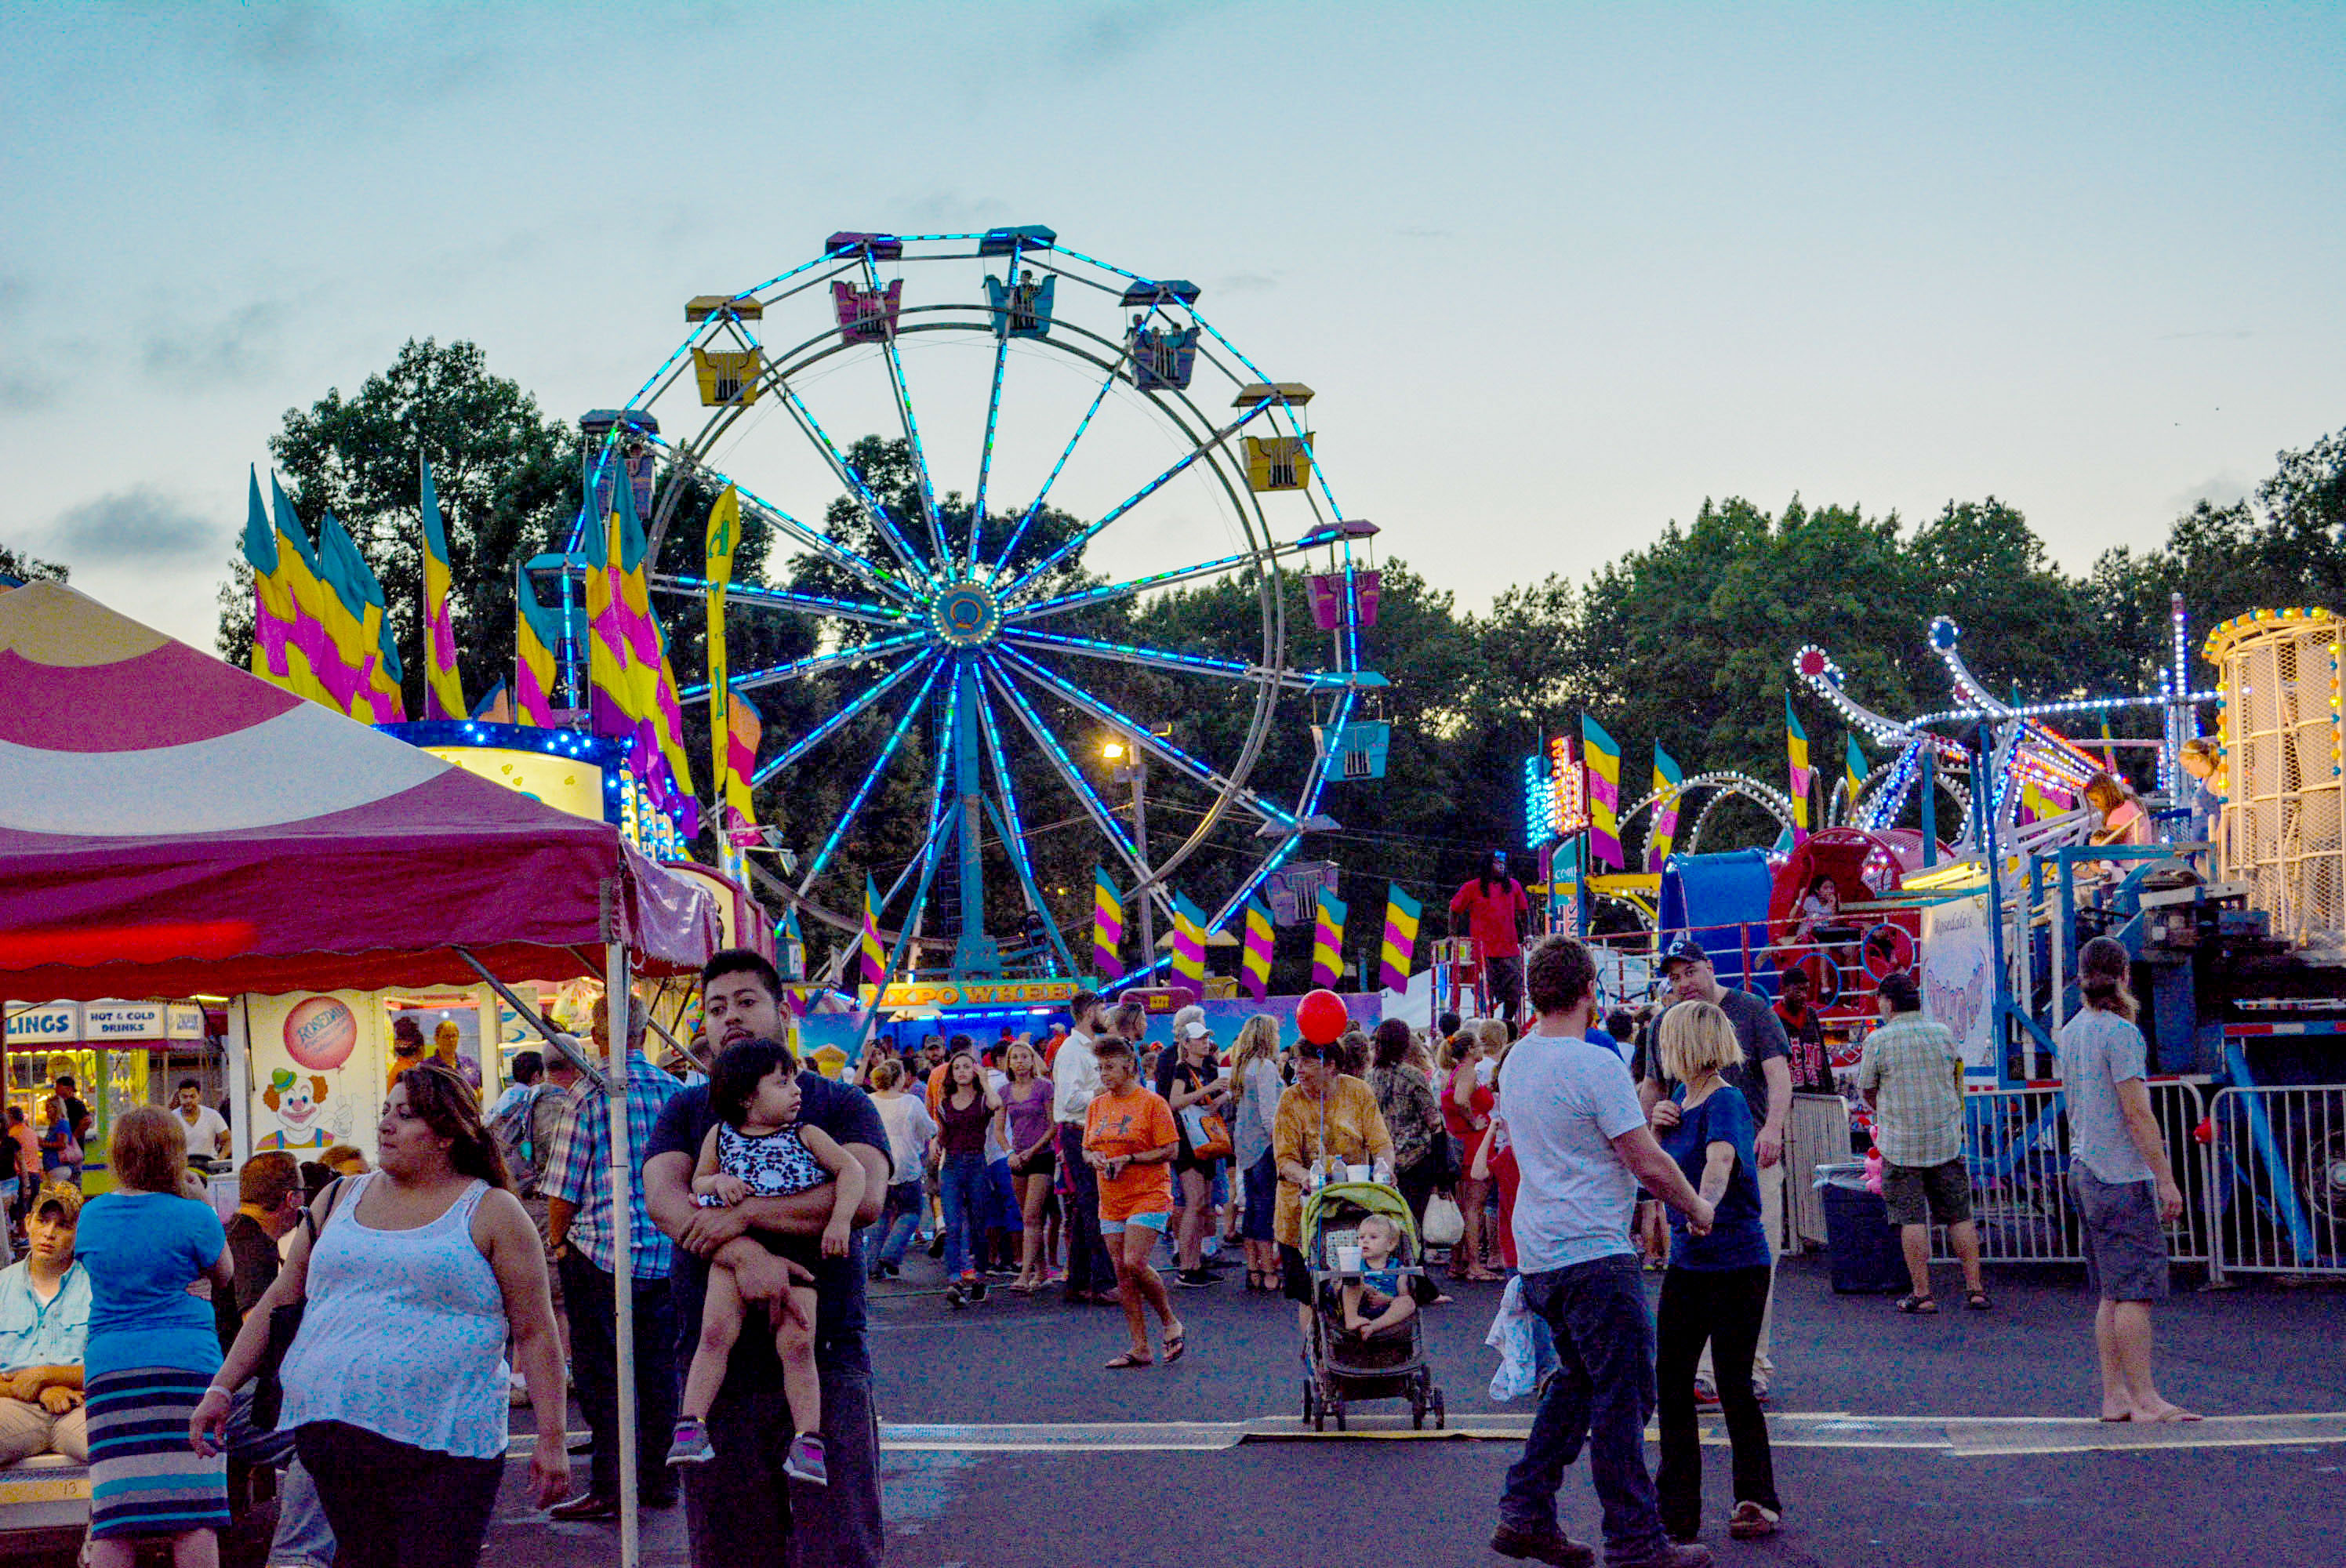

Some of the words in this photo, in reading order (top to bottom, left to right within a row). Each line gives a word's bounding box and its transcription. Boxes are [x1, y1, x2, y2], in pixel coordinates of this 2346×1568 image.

[1934, 911, 1972, 935] Rosedale's
[864, 986, 959, 1007] EXPO
[91, 1012, 113, 1021] HOT
[127, 1011, 155, 1020] COLD
[102, 1023, 144, 1033] DRINKS
